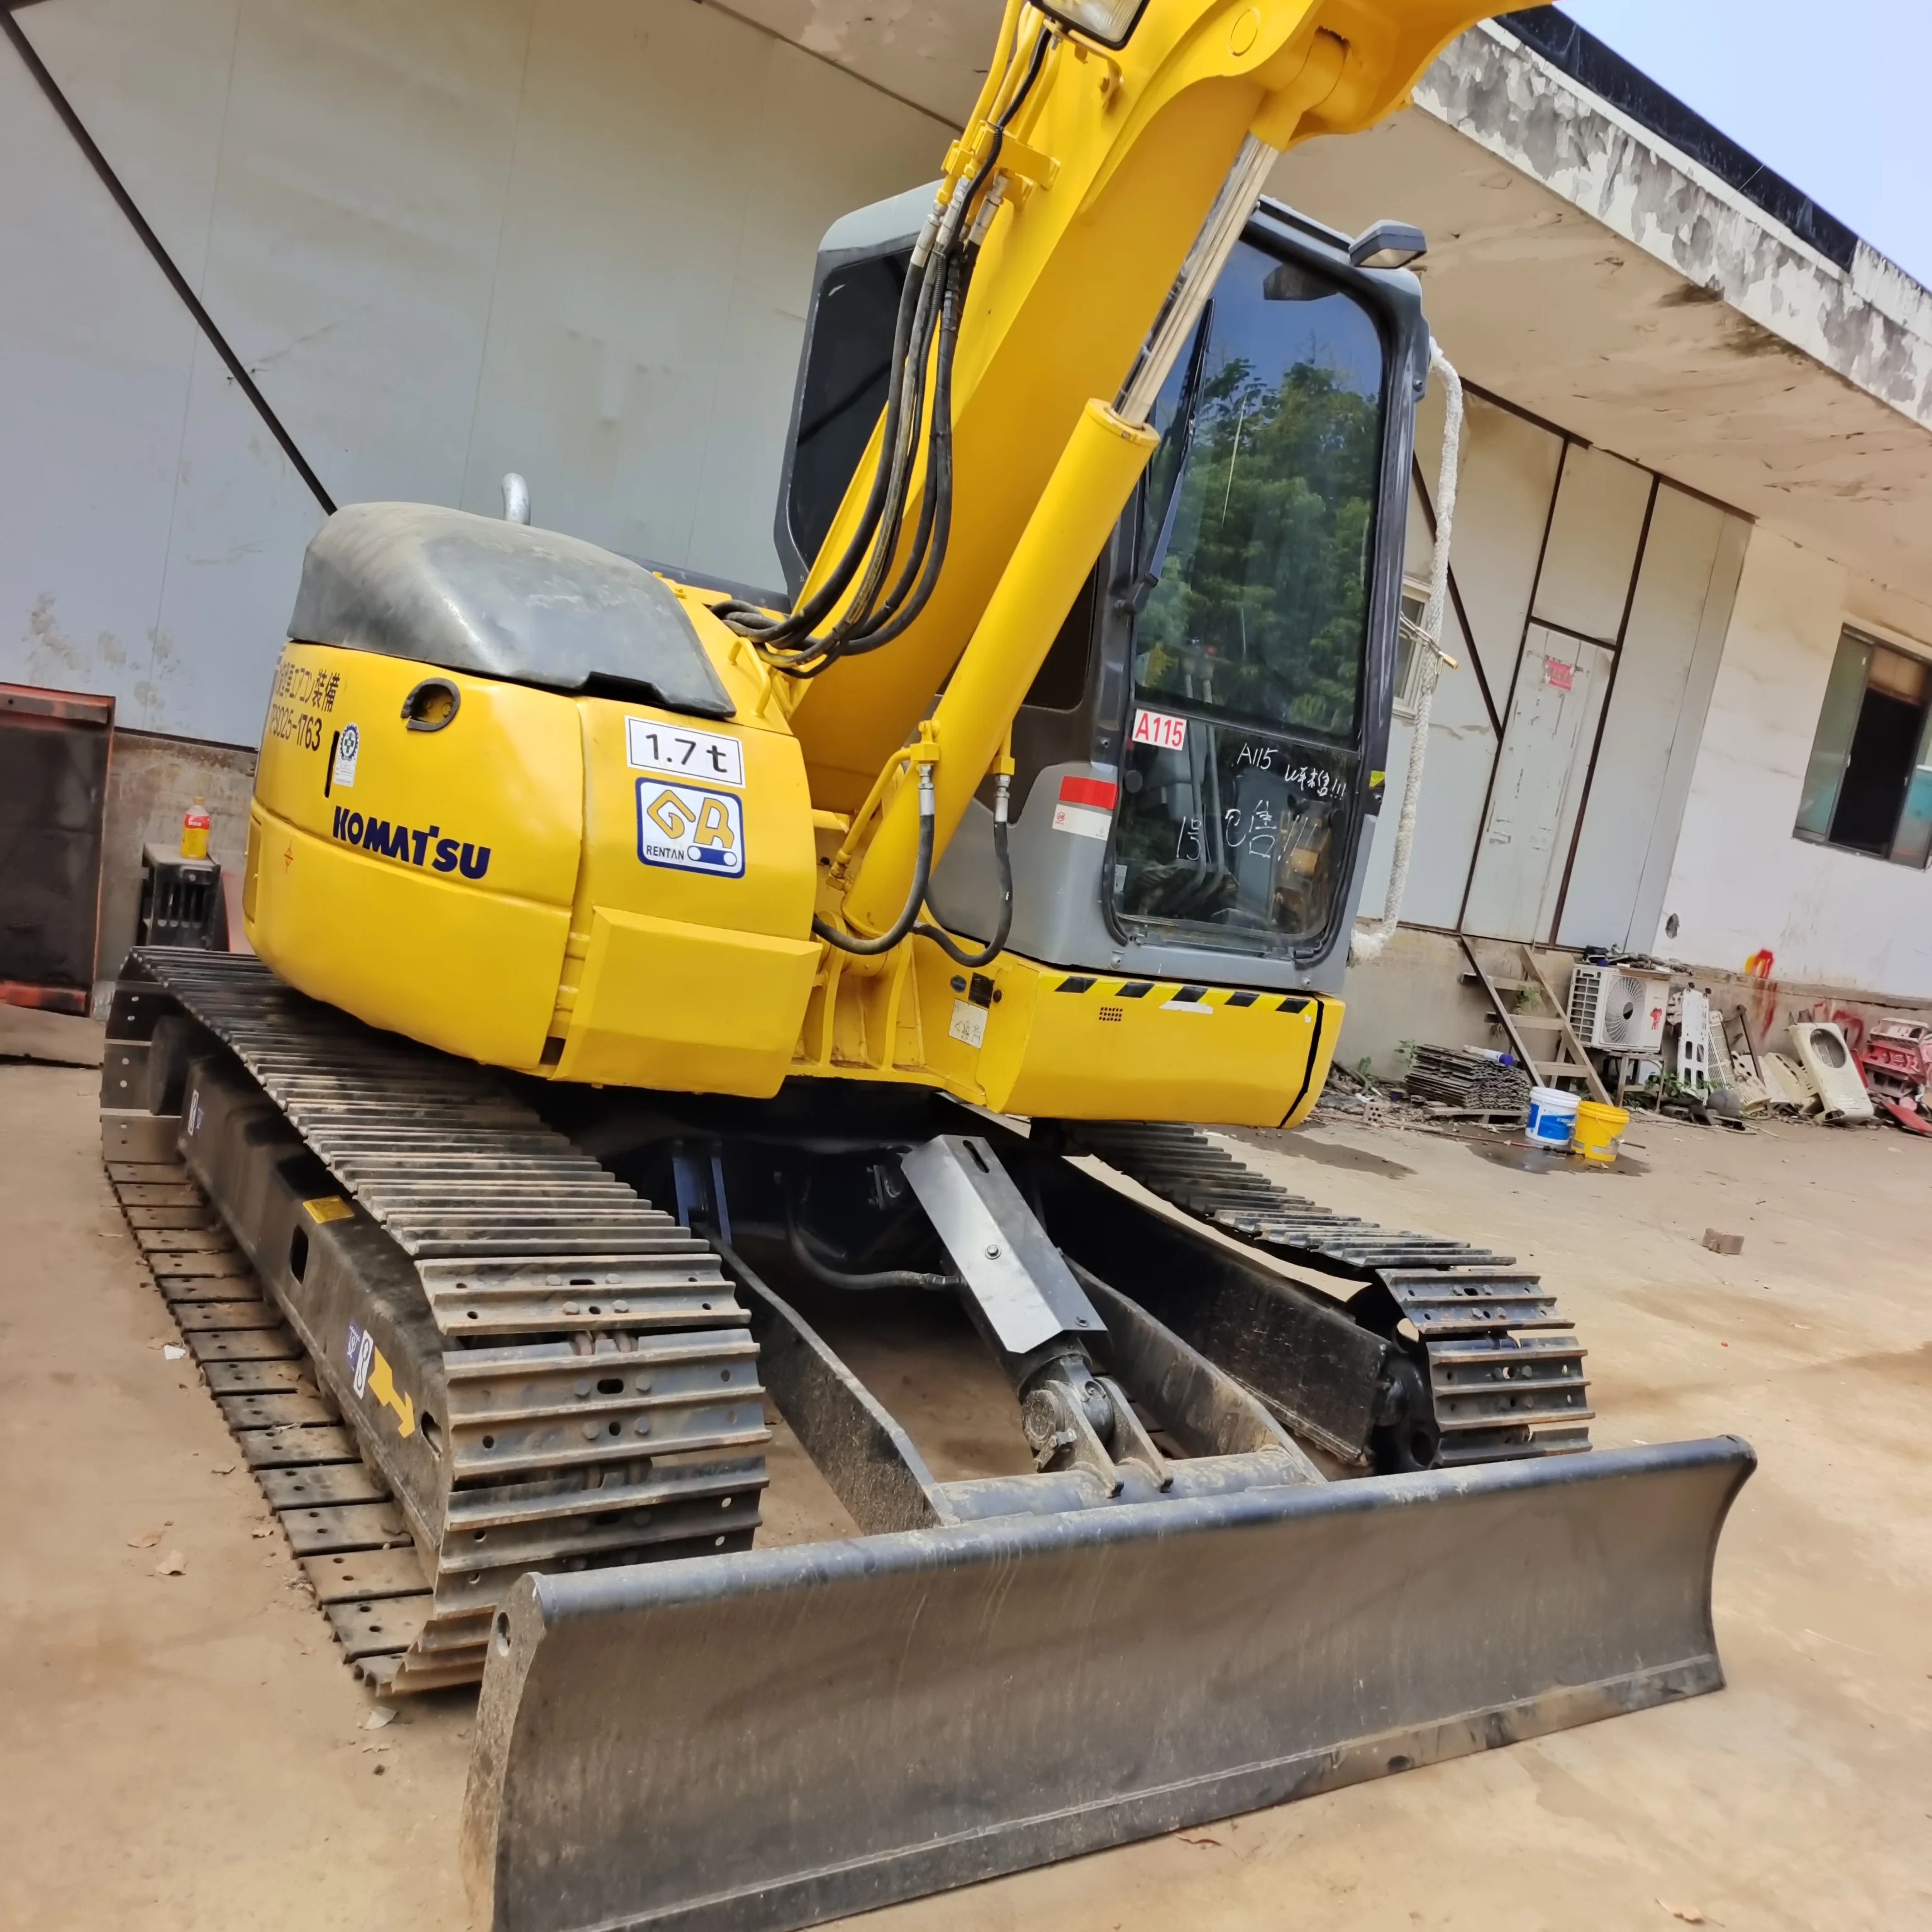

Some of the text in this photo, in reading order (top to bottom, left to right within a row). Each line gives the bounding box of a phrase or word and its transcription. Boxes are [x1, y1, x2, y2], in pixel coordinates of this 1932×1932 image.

[1135, 713, 1184, 747] A115
[1236, 743, 1279, 769] A115
[333, 805, 491, 879] KOMATSU
[646, 845, 684, 860] RENTAN
